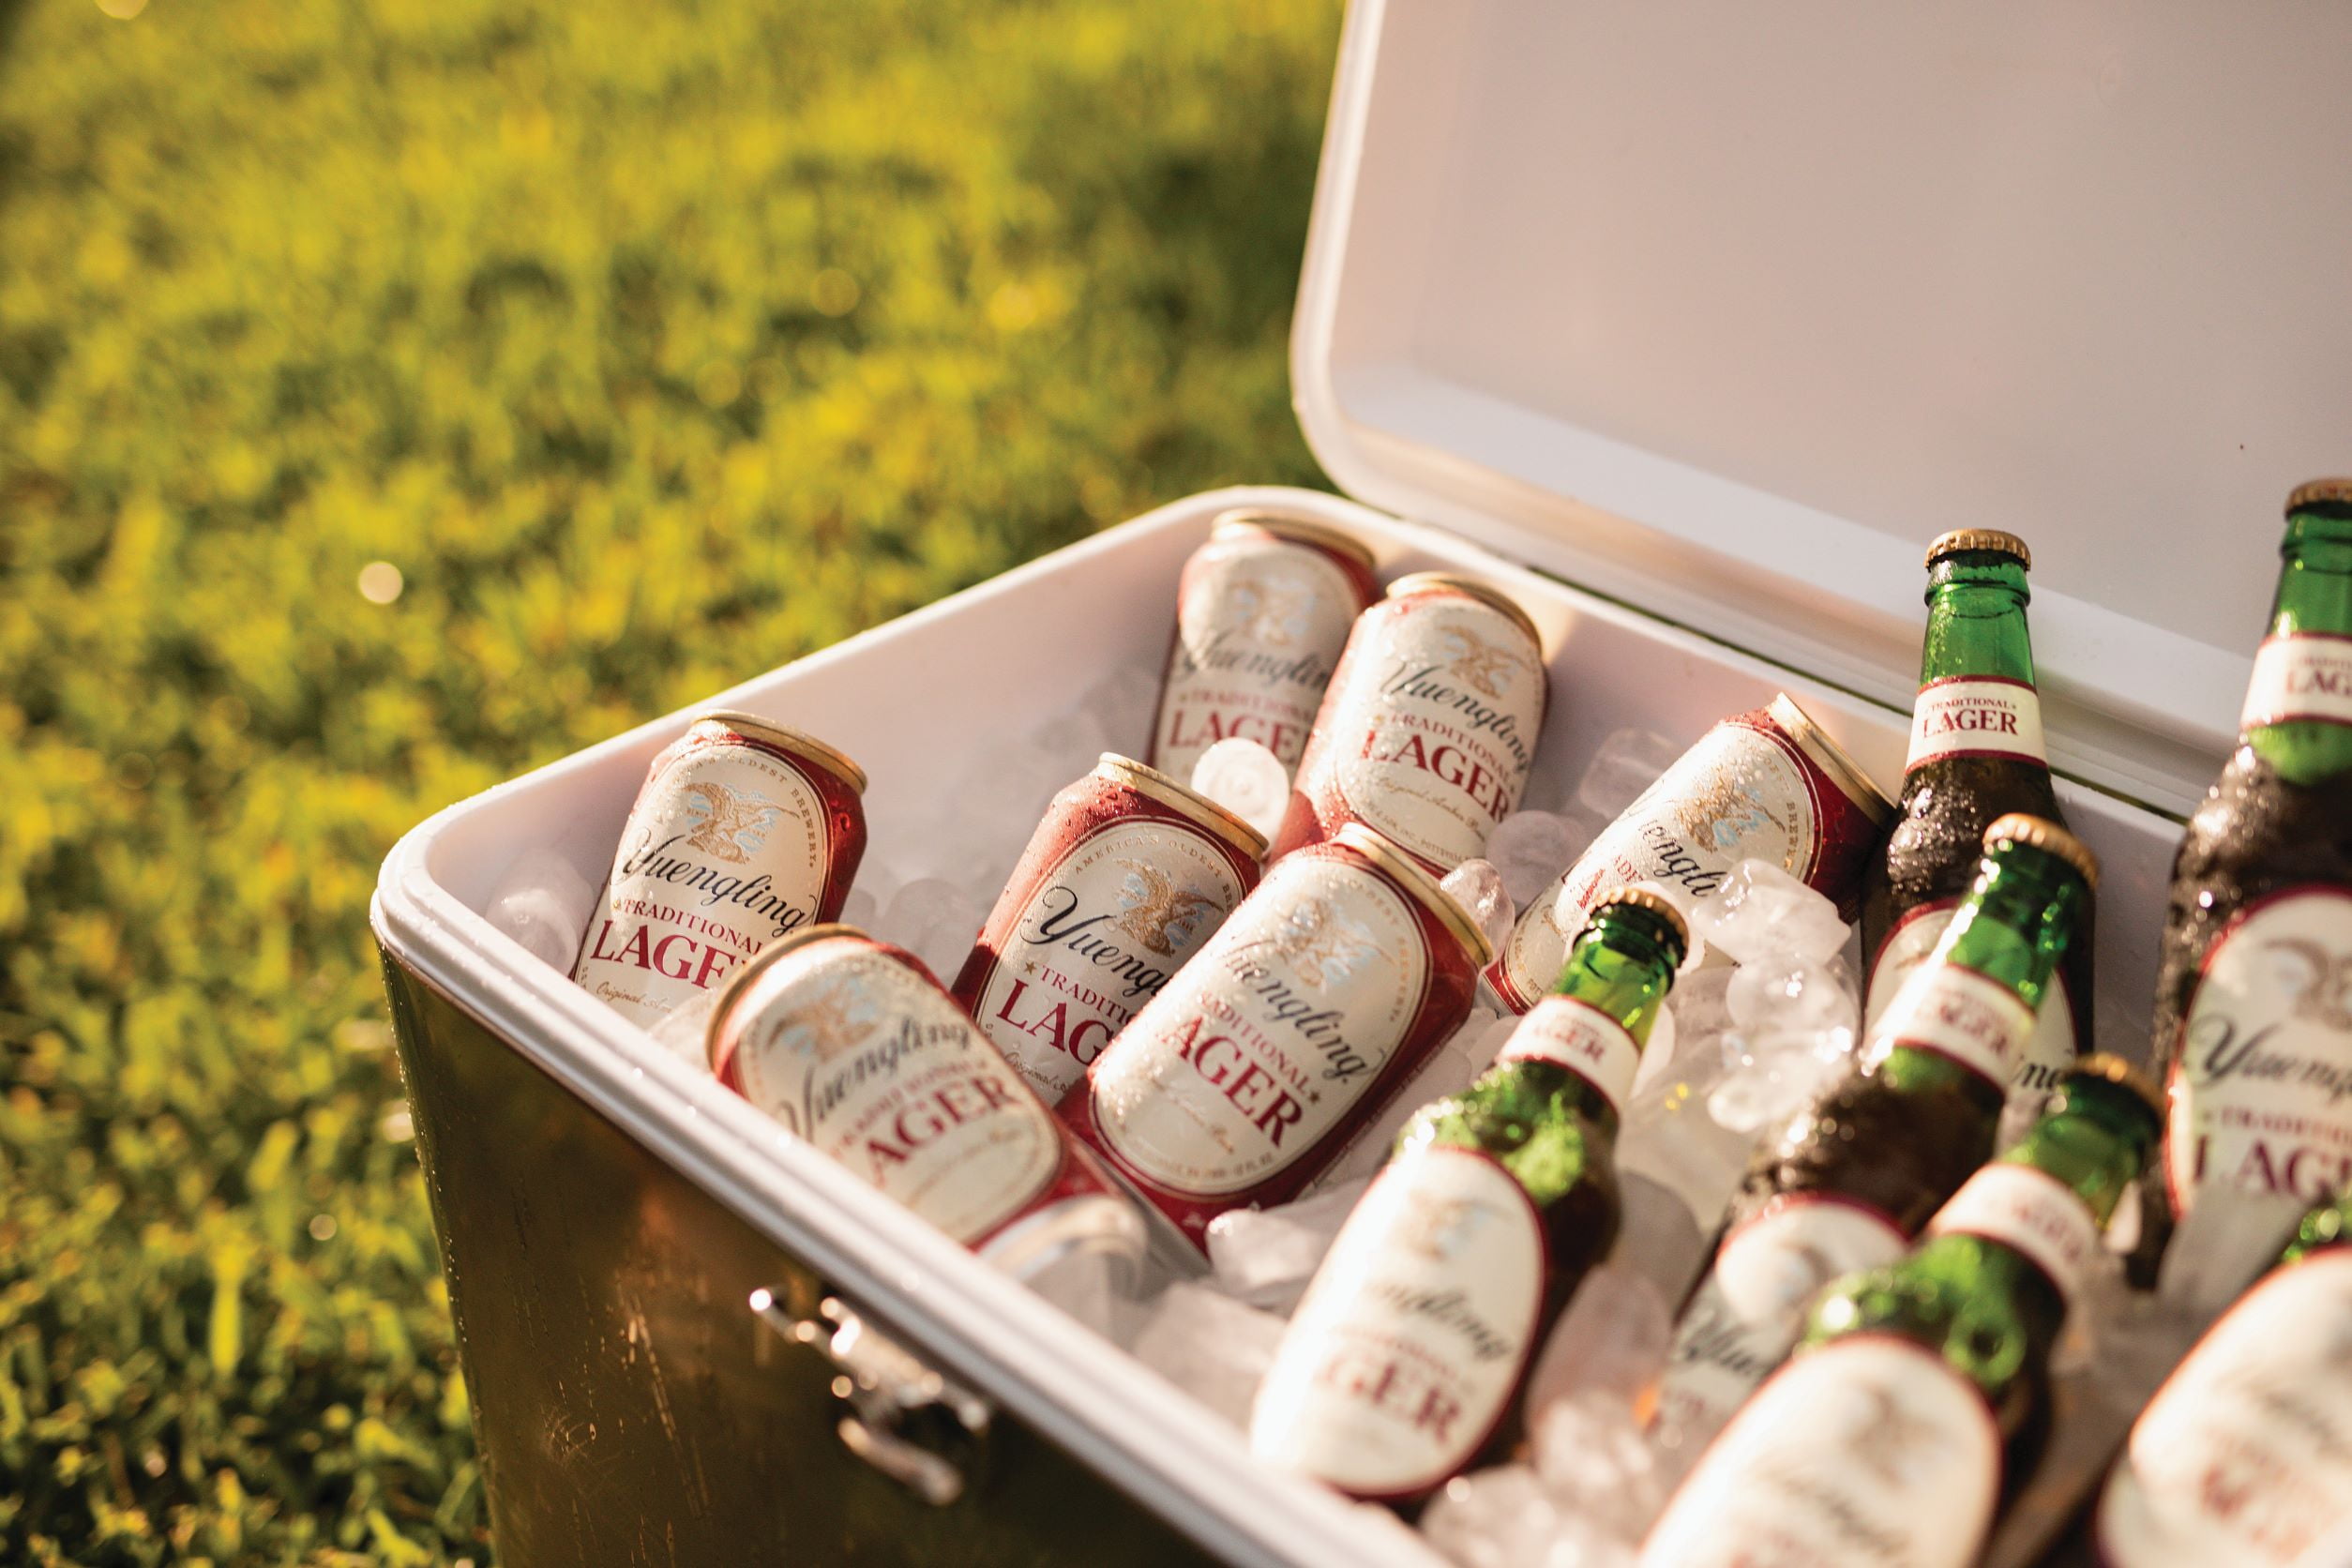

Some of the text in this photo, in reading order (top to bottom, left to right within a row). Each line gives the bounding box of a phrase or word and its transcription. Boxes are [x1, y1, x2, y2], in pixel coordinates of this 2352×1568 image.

[1168, 709, 1302, 765] LAGE
[1362, 730, 1510, 823] LAGER
[790, 787, 817, 862] BREWERY
[1641, 818, 1727, 897] engli
[611, 826, 818, 938] Yuengling
[590, 919, 750, 990] LAGE
[1019, 885, 1171, 999] Yueng
[996, 977, 1116, 1067] LAG
[1040, 965, 1138, 1026] TRADITI
[1223, 943, 1386, 1081] uengling
[1157, 1016, 1303, 1148] AGER
[867, 1071, 1020, 1191] AGER
